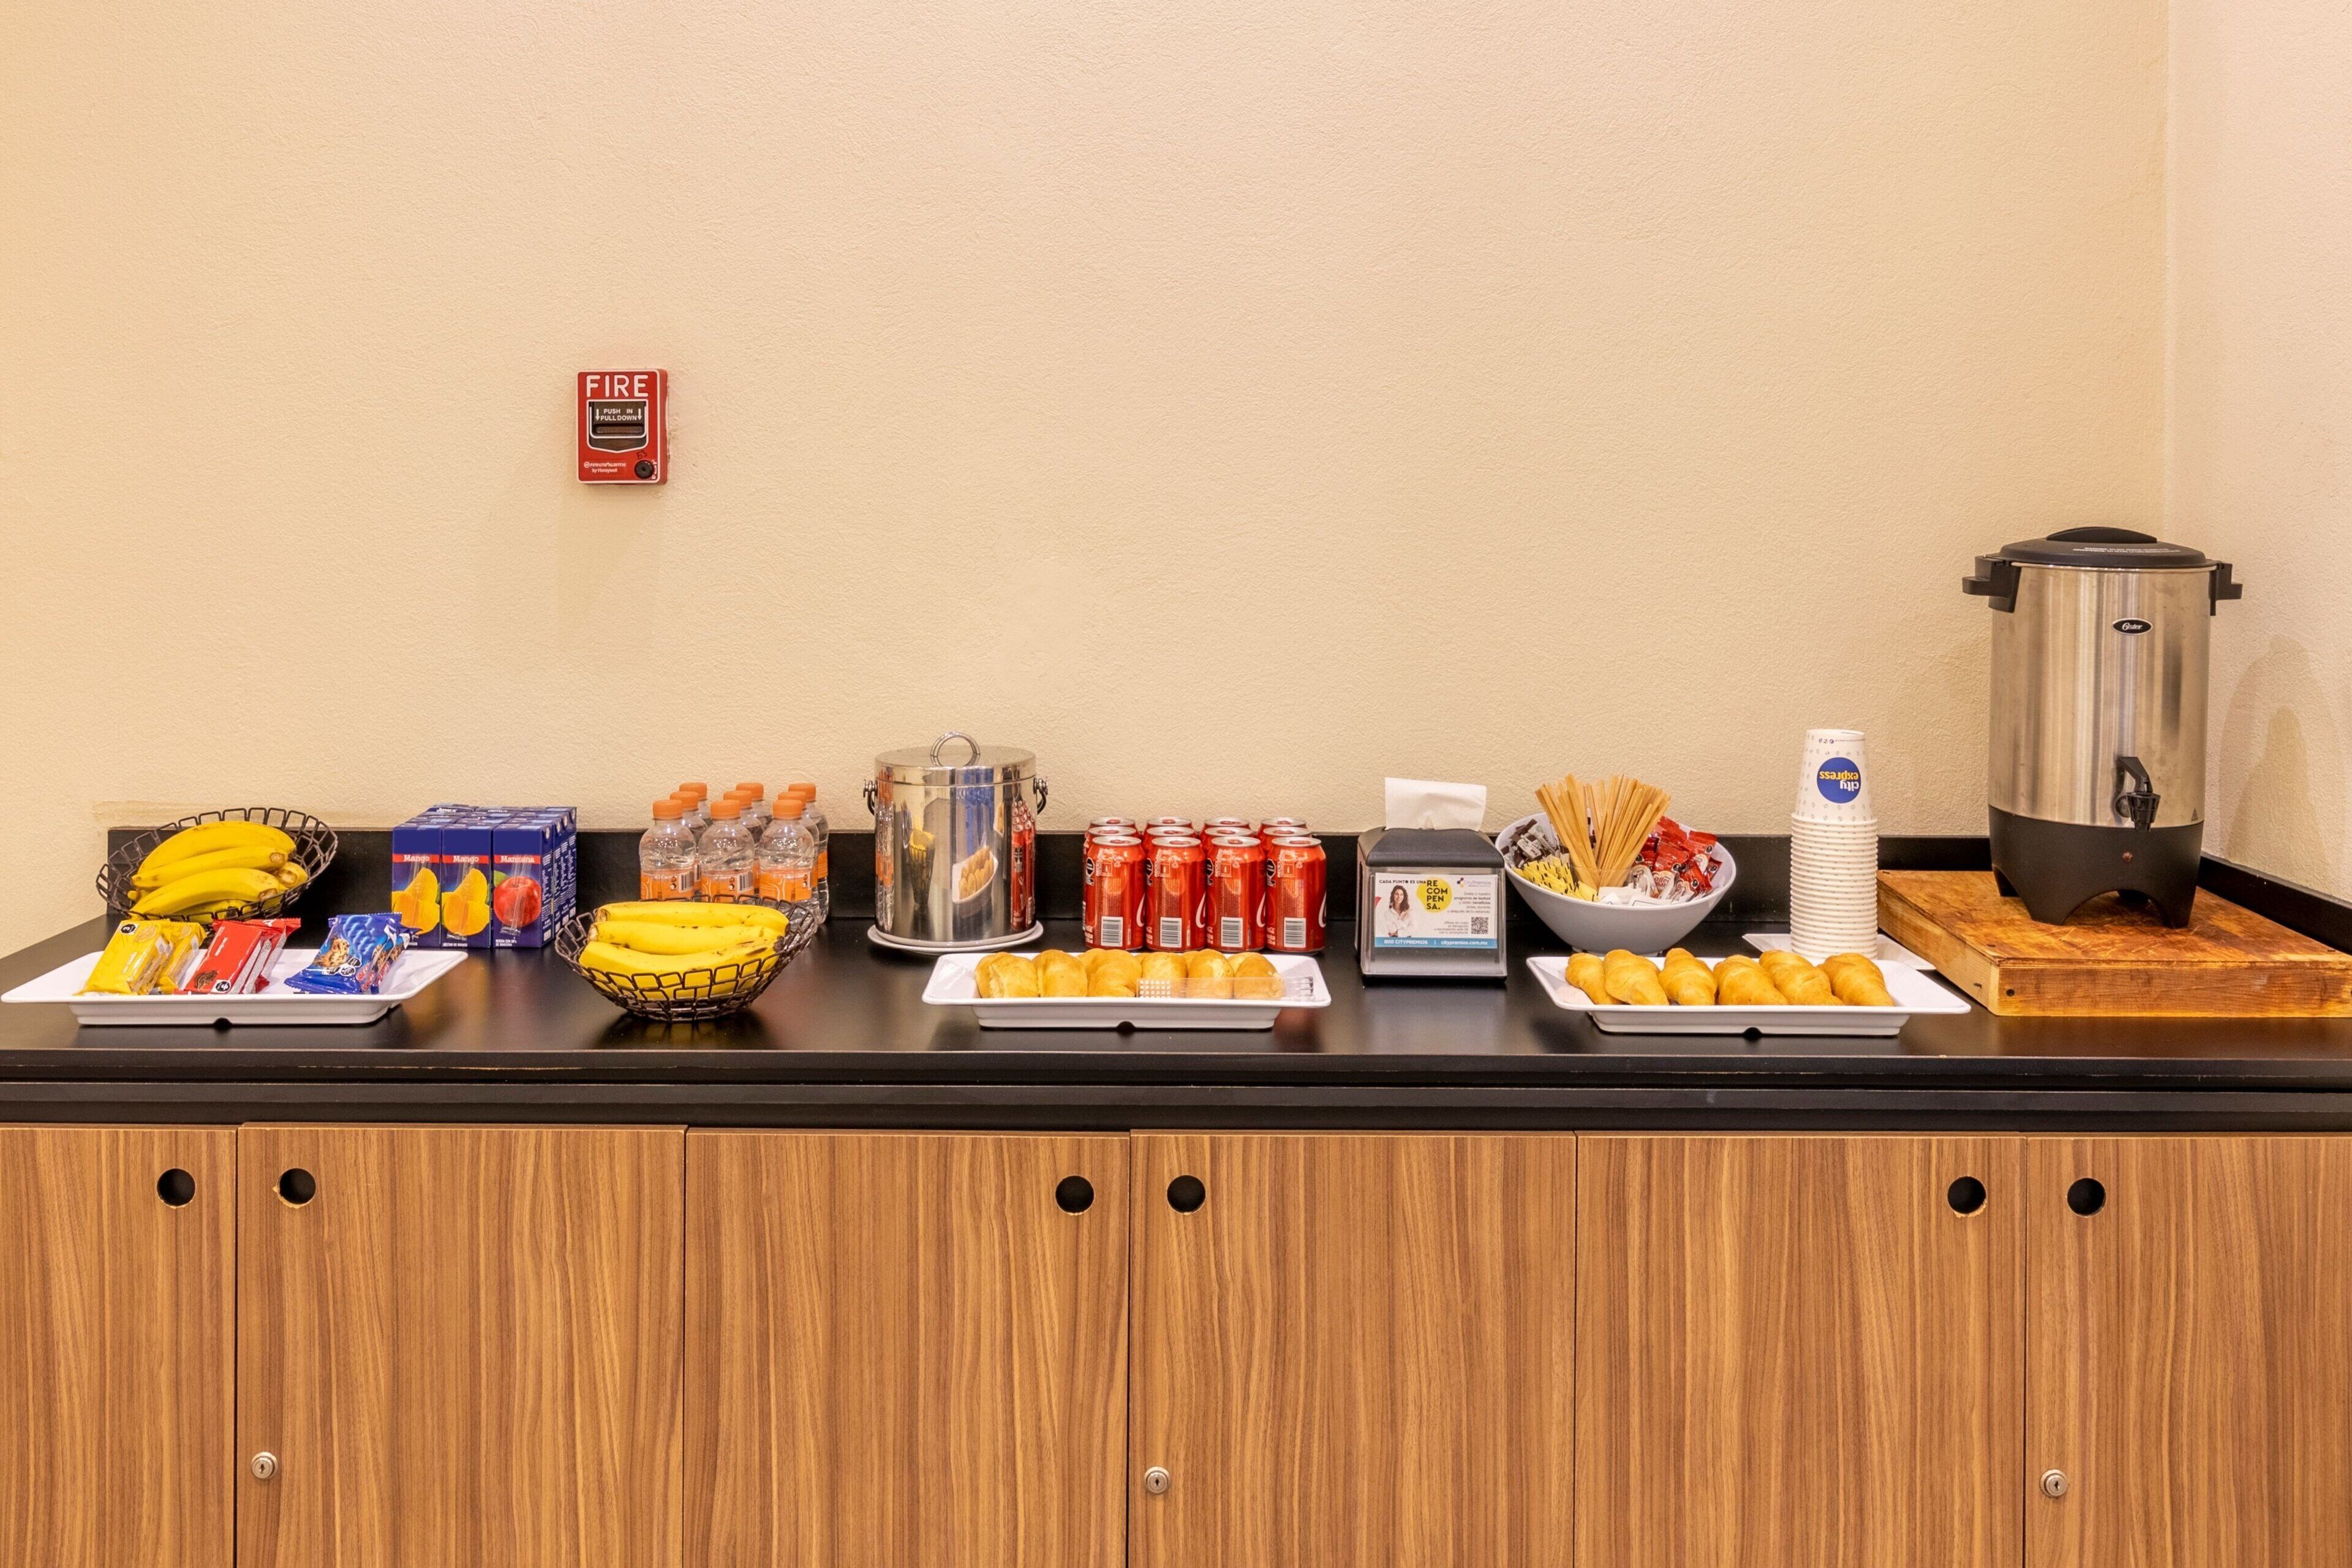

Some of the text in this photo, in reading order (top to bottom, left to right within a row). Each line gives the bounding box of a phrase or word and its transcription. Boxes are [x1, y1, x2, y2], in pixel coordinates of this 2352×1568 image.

[586, 375, 649, 398] FIRE
[2122, 622, 2143, 631] Oster
[1819, 771, 1859, 780] express
[1839, 780, 1860, 791] city
[404, 854, 430, 864] Mango
[453, 855, 479, 864] Mango
